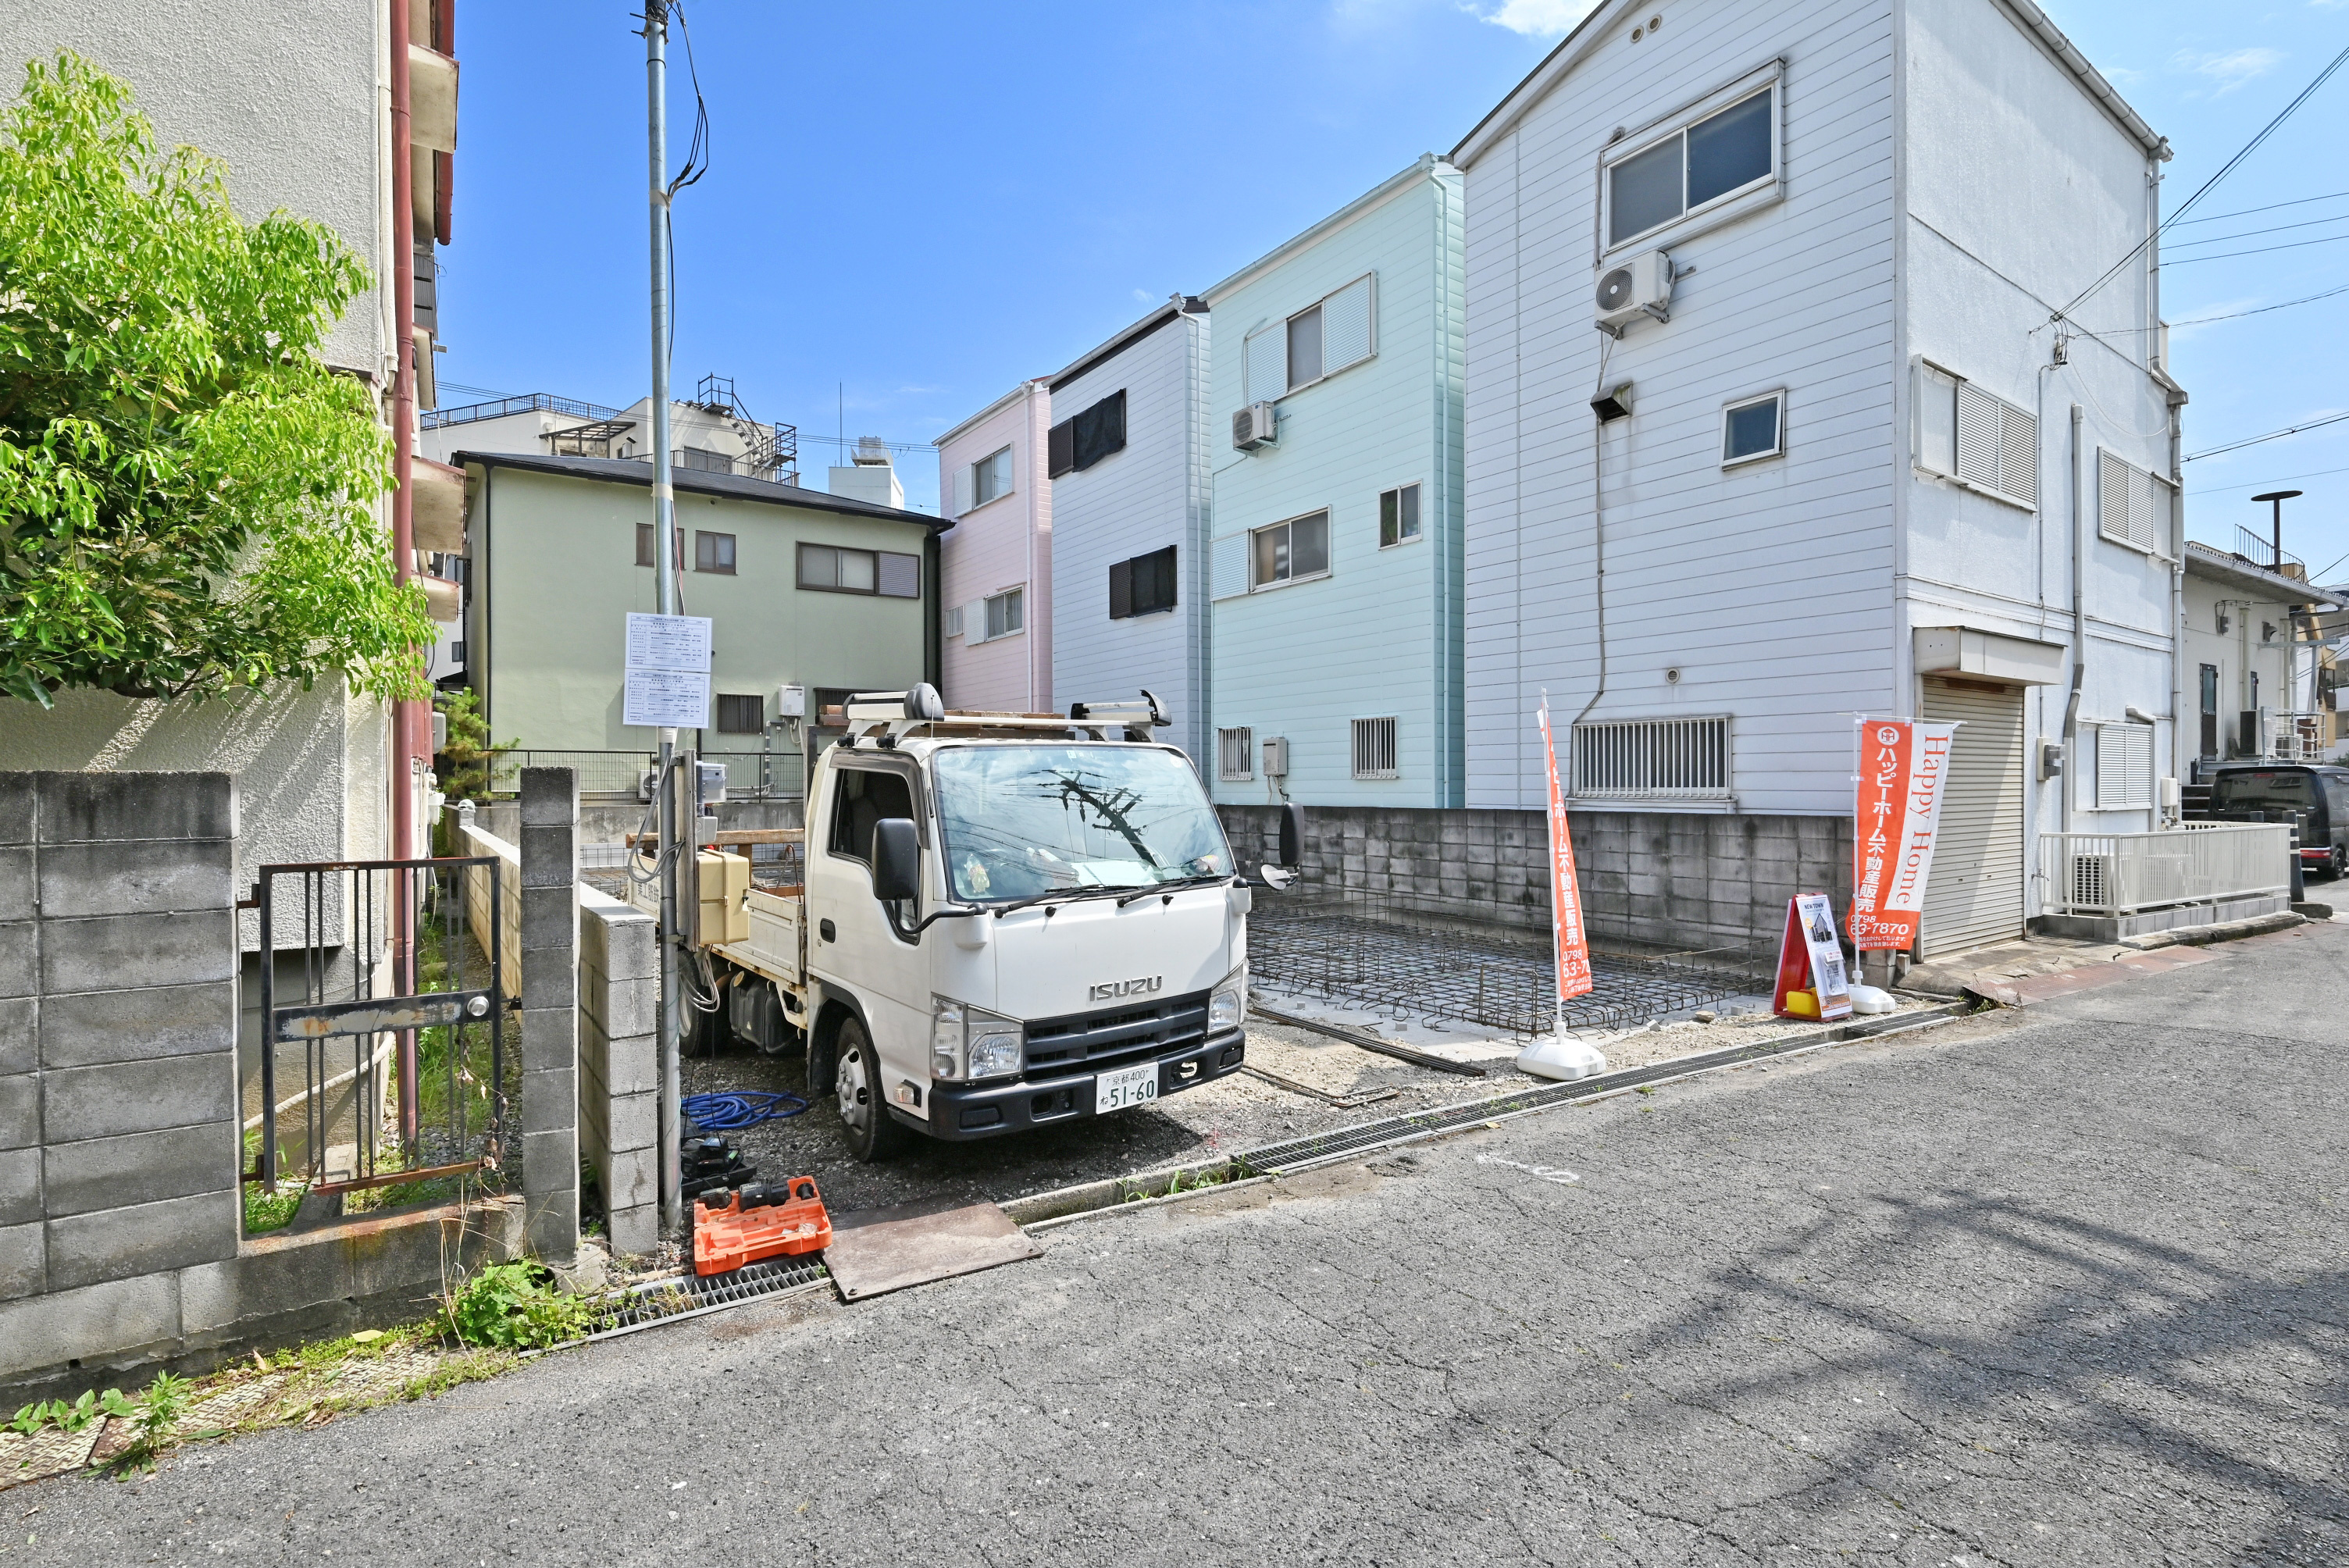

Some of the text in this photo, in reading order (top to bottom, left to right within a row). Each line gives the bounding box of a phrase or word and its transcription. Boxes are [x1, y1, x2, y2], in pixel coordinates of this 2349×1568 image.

[1858, 747, 1898, 913] ハッピーホーム不動産販売
[1896, 734, 1948, 904] Happy Home
[1551, 743, 1578, 946] ピーホーム不動産販売
[1850, 914, 1877, 923] 0798
[1850, 923, 1909, 935] 63-7870
[1563, 949, 1582, 961] 0798
[1089, 975, 1162, 1001] ISUZU
[1110, 1079, 1155, 1107] 51-60
